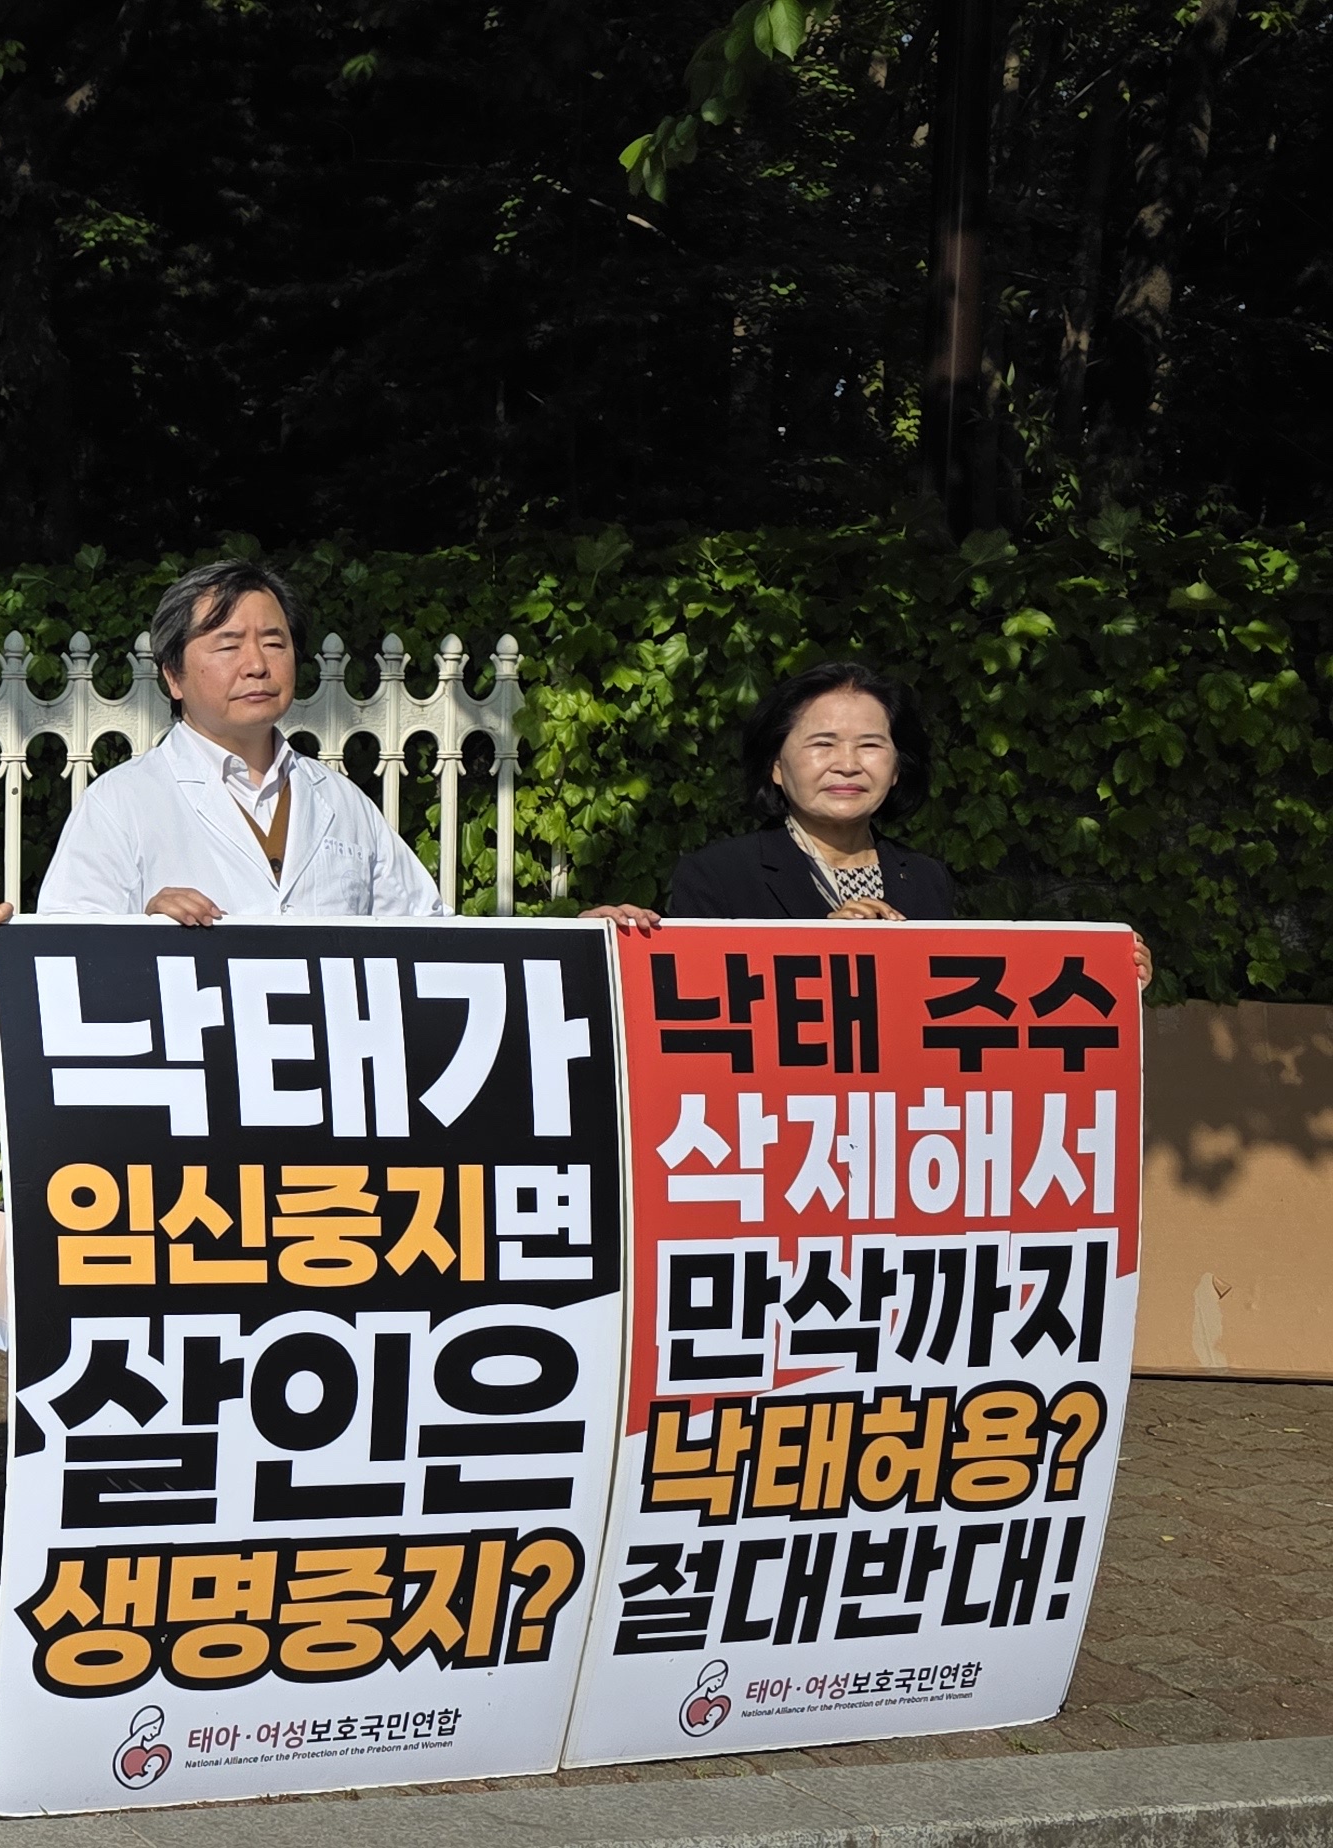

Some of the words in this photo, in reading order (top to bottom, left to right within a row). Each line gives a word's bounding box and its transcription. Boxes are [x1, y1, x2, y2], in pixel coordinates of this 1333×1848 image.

[34, 955, 591, 1137] 낙태가
[650, 953, 880, 1073] 낙태
[922, 956, 1119, 1073] 주수
[656, 1087, 1117, 1223] 삭제해서
[46, 1162, 593, 1288] 임신중지면
[668, 1241, 1109, 1382] 만삭까지
[48, 1324, 586, 1529] 살인은
[651, 1390, 1102, 1517] 낙태허용?
[32, 1539, 576, 1688] 생명중지?
[613, 1515, 1086, 1656] 절대반대!
[184, 1758, 222, 1769] National
[223, 1754, 259, 1766] Alliance
[260, 1753, 274, 1763] for
[275, 1752, 290, 1761] the
[292, 1748, 337, 1760] Protection
[339, 1747, 349, 1756] of
[350, 1746, 365, 1755] the
[366, 1743, 401, 1754] Preborn
[402, 1741, 419, 1751] and
[421, 1739, 453, 1749] Women
